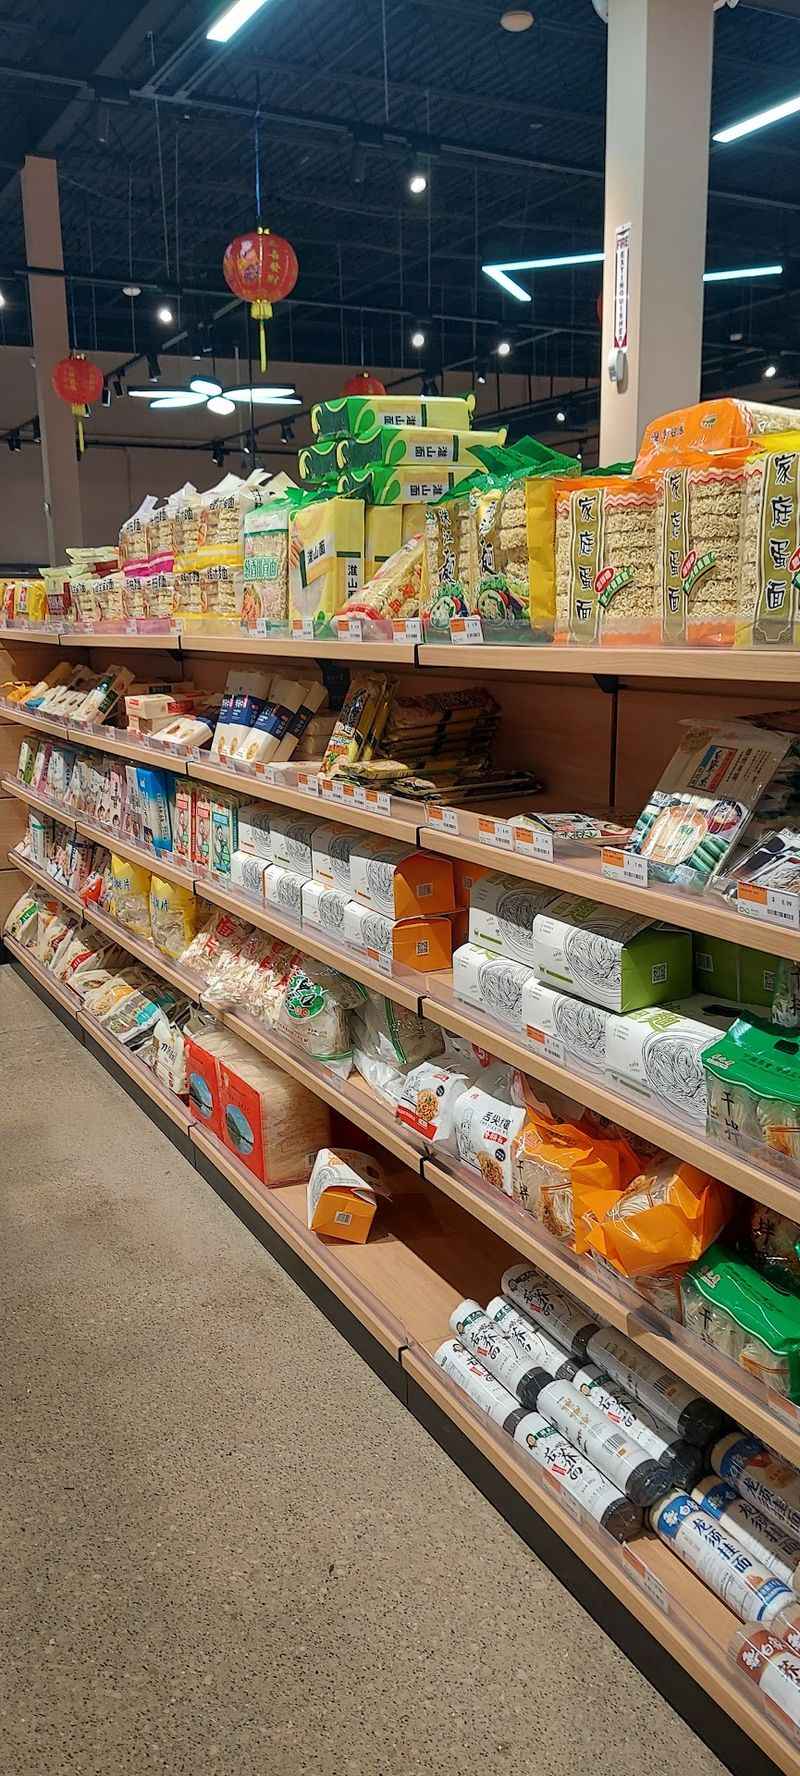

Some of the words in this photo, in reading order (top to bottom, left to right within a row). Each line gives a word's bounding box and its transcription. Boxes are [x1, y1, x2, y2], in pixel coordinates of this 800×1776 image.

[767, 453, 797, 610] 家庭蛋面
[691, 1518, 752, 1574] 龙须挂面
